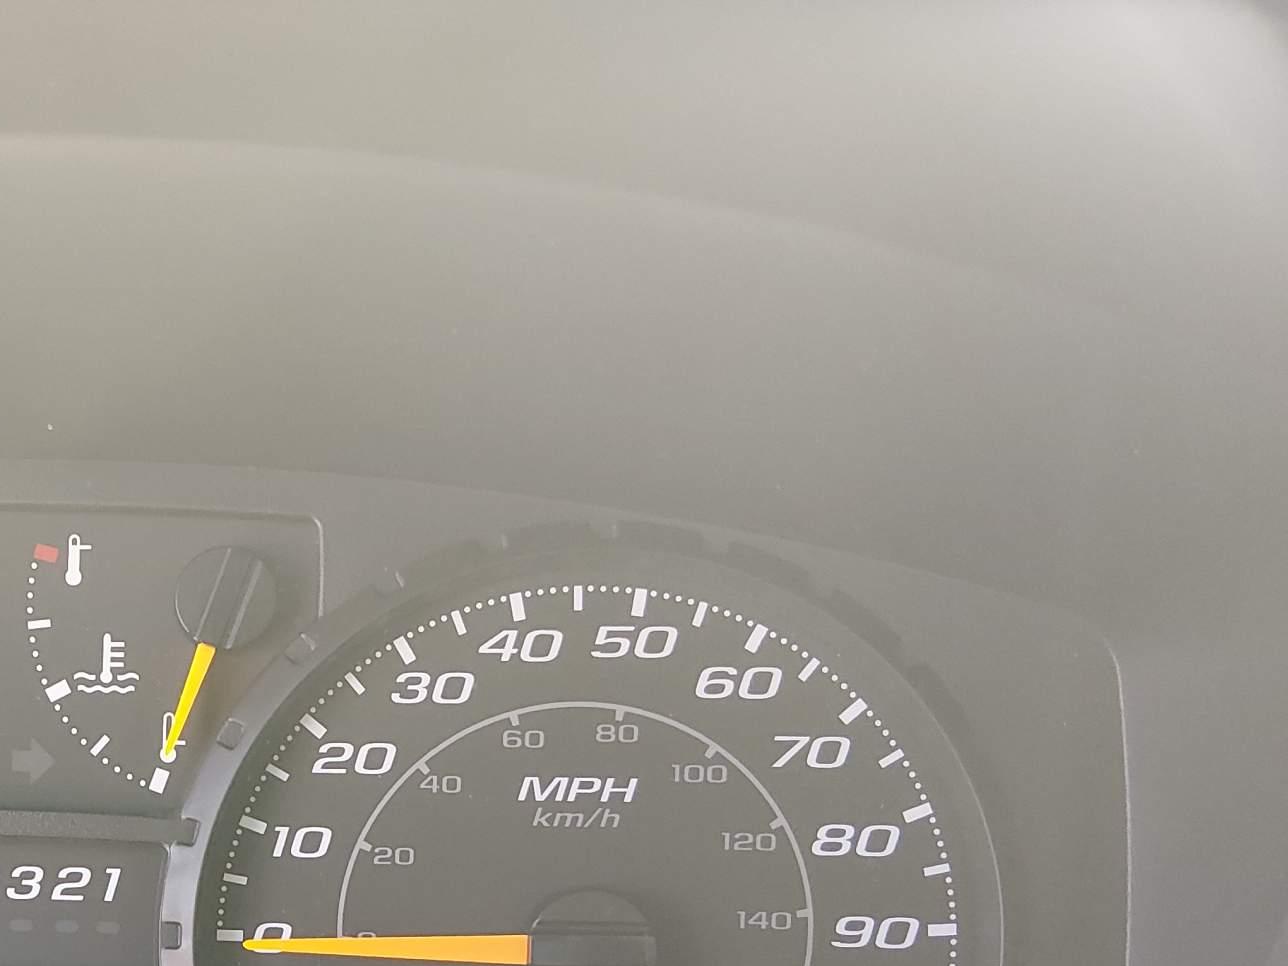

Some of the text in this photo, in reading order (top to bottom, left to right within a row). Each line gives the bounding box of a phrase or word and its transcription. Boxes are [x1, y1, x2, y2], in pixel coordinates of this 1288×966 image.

[478, 629, 564, 663] 40
[590, 625, 679, 659] 50
[390, 672, 475, 704] 30
[695, 666, 783, 700] 60
[502, 729, 545, 749] 60
[595, 724, 639, 743] 80
[311, 742, 397, 775] 20
[771, 735, 851, 769] 70
[419, 775, 462, 794] 40
[671, 764, 728, 784] 100
[517, 776, 639, 803] MPH
[532, 807, 620, 828] km/h
[272, 826, 332, 858] 10
[721, 832, 777, 852] 120
[811, 823, 901, 857] 80
[373, 847, 415, 866] 20
[736, 910, 792, 930] 140
[831, 916, 920, 949] 90
